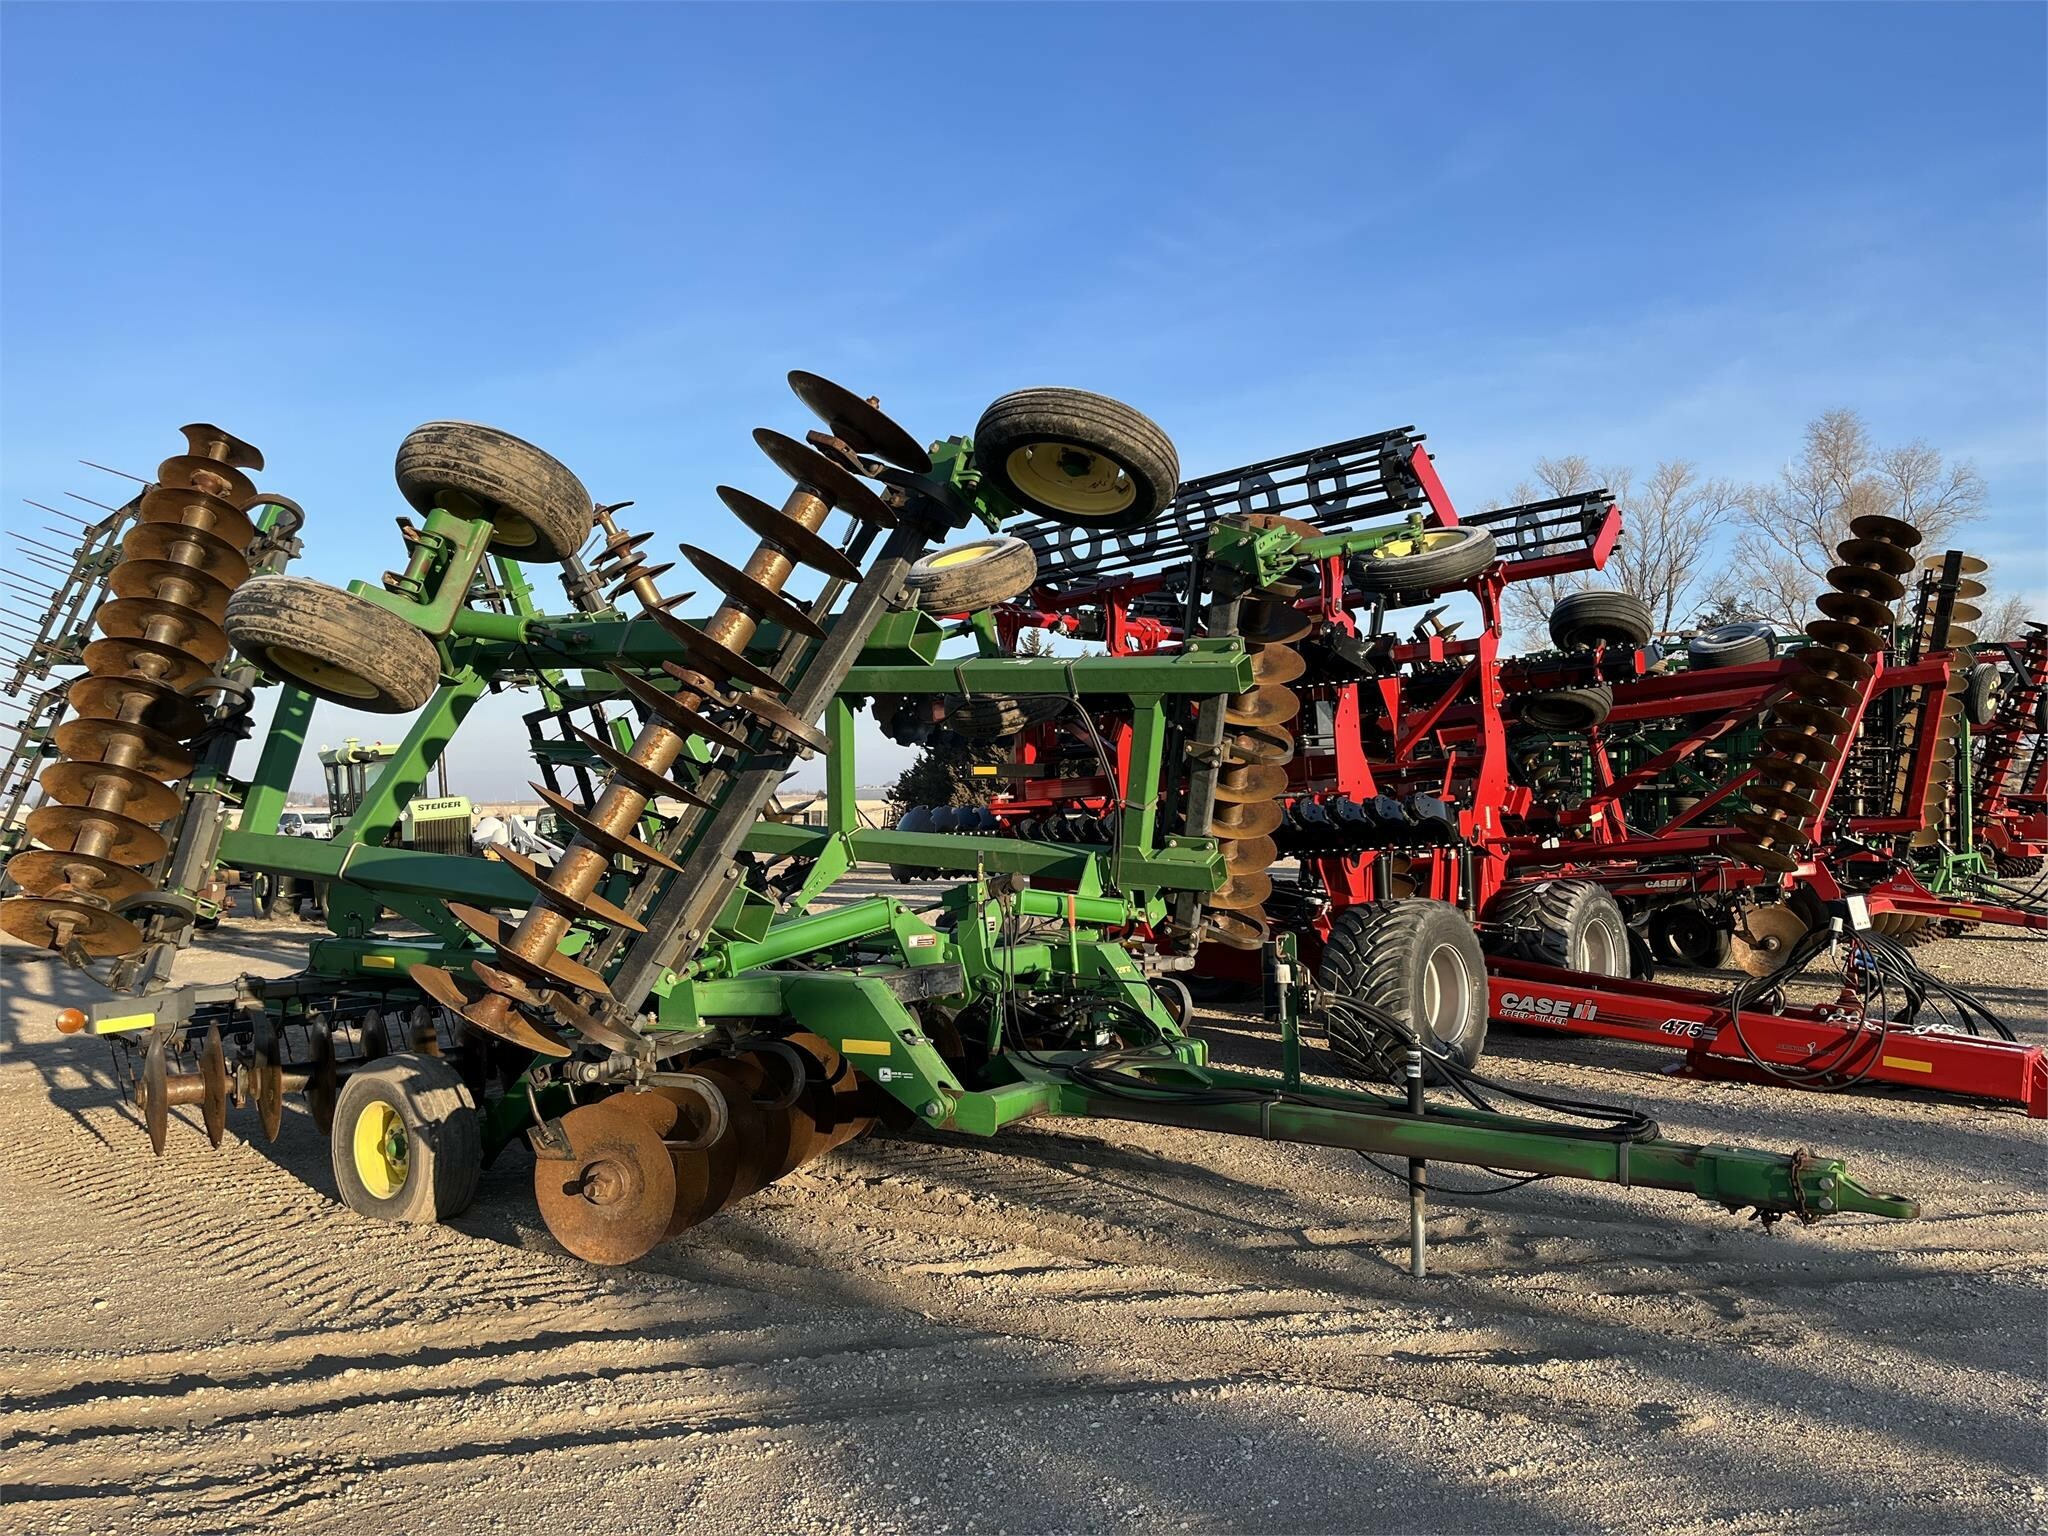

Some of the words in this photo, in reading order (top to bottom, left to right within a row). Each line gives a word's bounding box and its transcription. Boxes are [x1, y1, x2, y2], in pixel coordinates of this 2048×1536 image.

[417, 801, 461, 811] STEIGER
[1645, 880, 1676, 888] CASE
[1500, 992, 1571, 1017] CASE
[1660, 1018, 1704, 1039] 475
